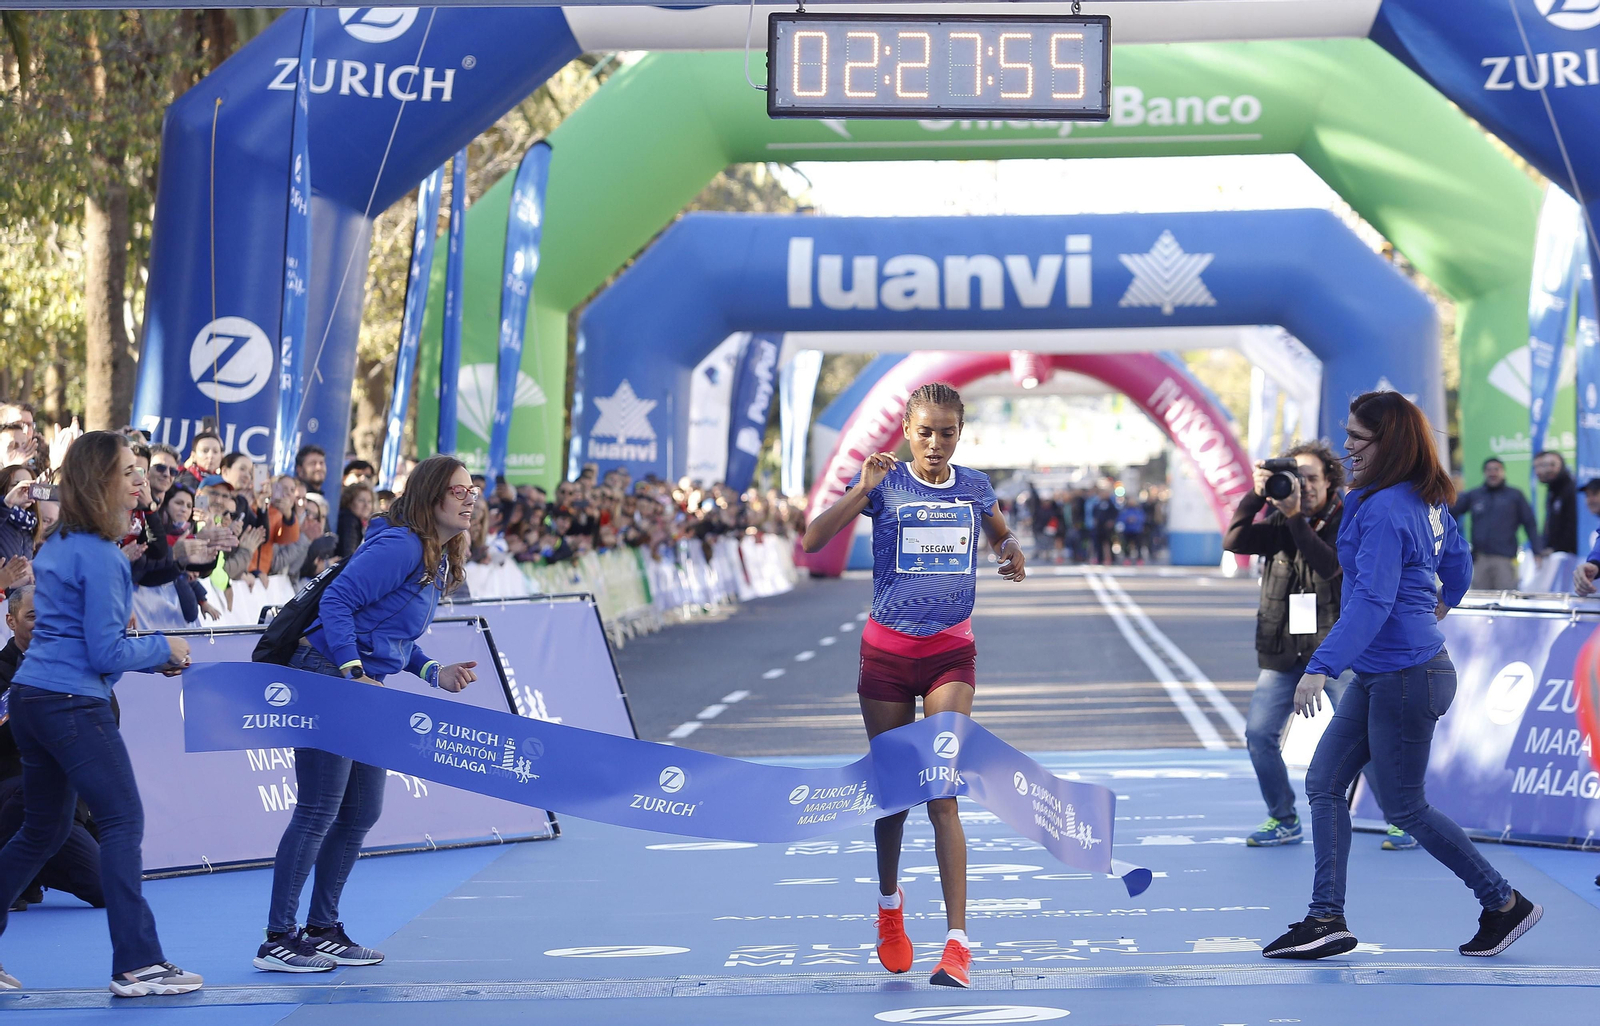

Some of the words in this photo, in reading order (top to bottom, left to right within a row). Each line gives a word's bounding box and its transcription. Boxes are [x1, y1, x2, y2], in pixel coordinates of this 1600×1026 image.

[792, 30, 1086, 101] 02:27:55
[267, 57, 456, 103] ZURICH
[1111, 86, 1263, 127] Banco
[787, 234, 1093, 311] luanvi
[588, 438, 659, 462] luanvi
[929, 512, 958, 520] ZURICH
[920, 545, 955, 553] TSEGAW
[242, 713, 314, 730] ZURICH
[437, 721, 499, 747] ZURICH
[1524, 726, 1593, 758] MARA
[435, 738, 497, 762] MARATÓN
[433, 752, 487, 775] MÁLAGA
[810, 783, 858, 800] ZURICH
[1511, 761, 1600, 800] MÁLAG
[629, 793, 697, 817] ZURICH
[803, 798, 852, 813] MARATÓN
[1029, 782, 1062, 813] ZURICH
[797, 812, 838, 825] MÁLAGA
